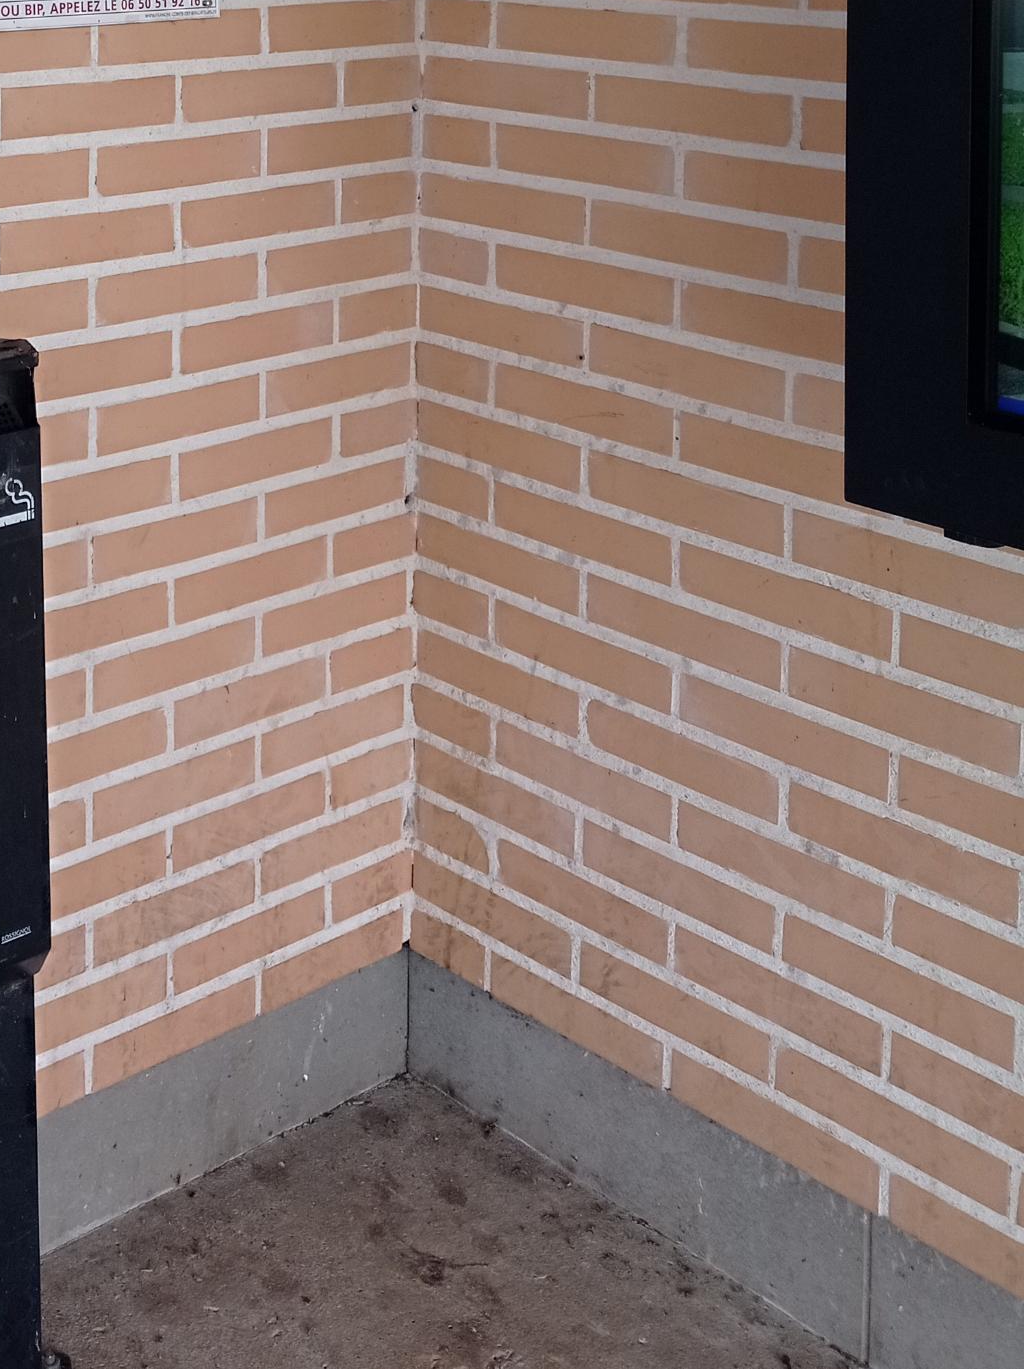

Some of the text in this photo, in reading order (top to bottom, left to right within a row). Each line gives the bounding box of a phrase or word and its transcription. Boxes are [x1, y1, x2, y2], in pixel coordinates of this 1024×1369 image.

[0, 4, 20, 17] OU
[25, 3, 45, 17] BIP,
[50, 0, 101, 15] APPELEZ
[105, 0, 117, 11] LE
